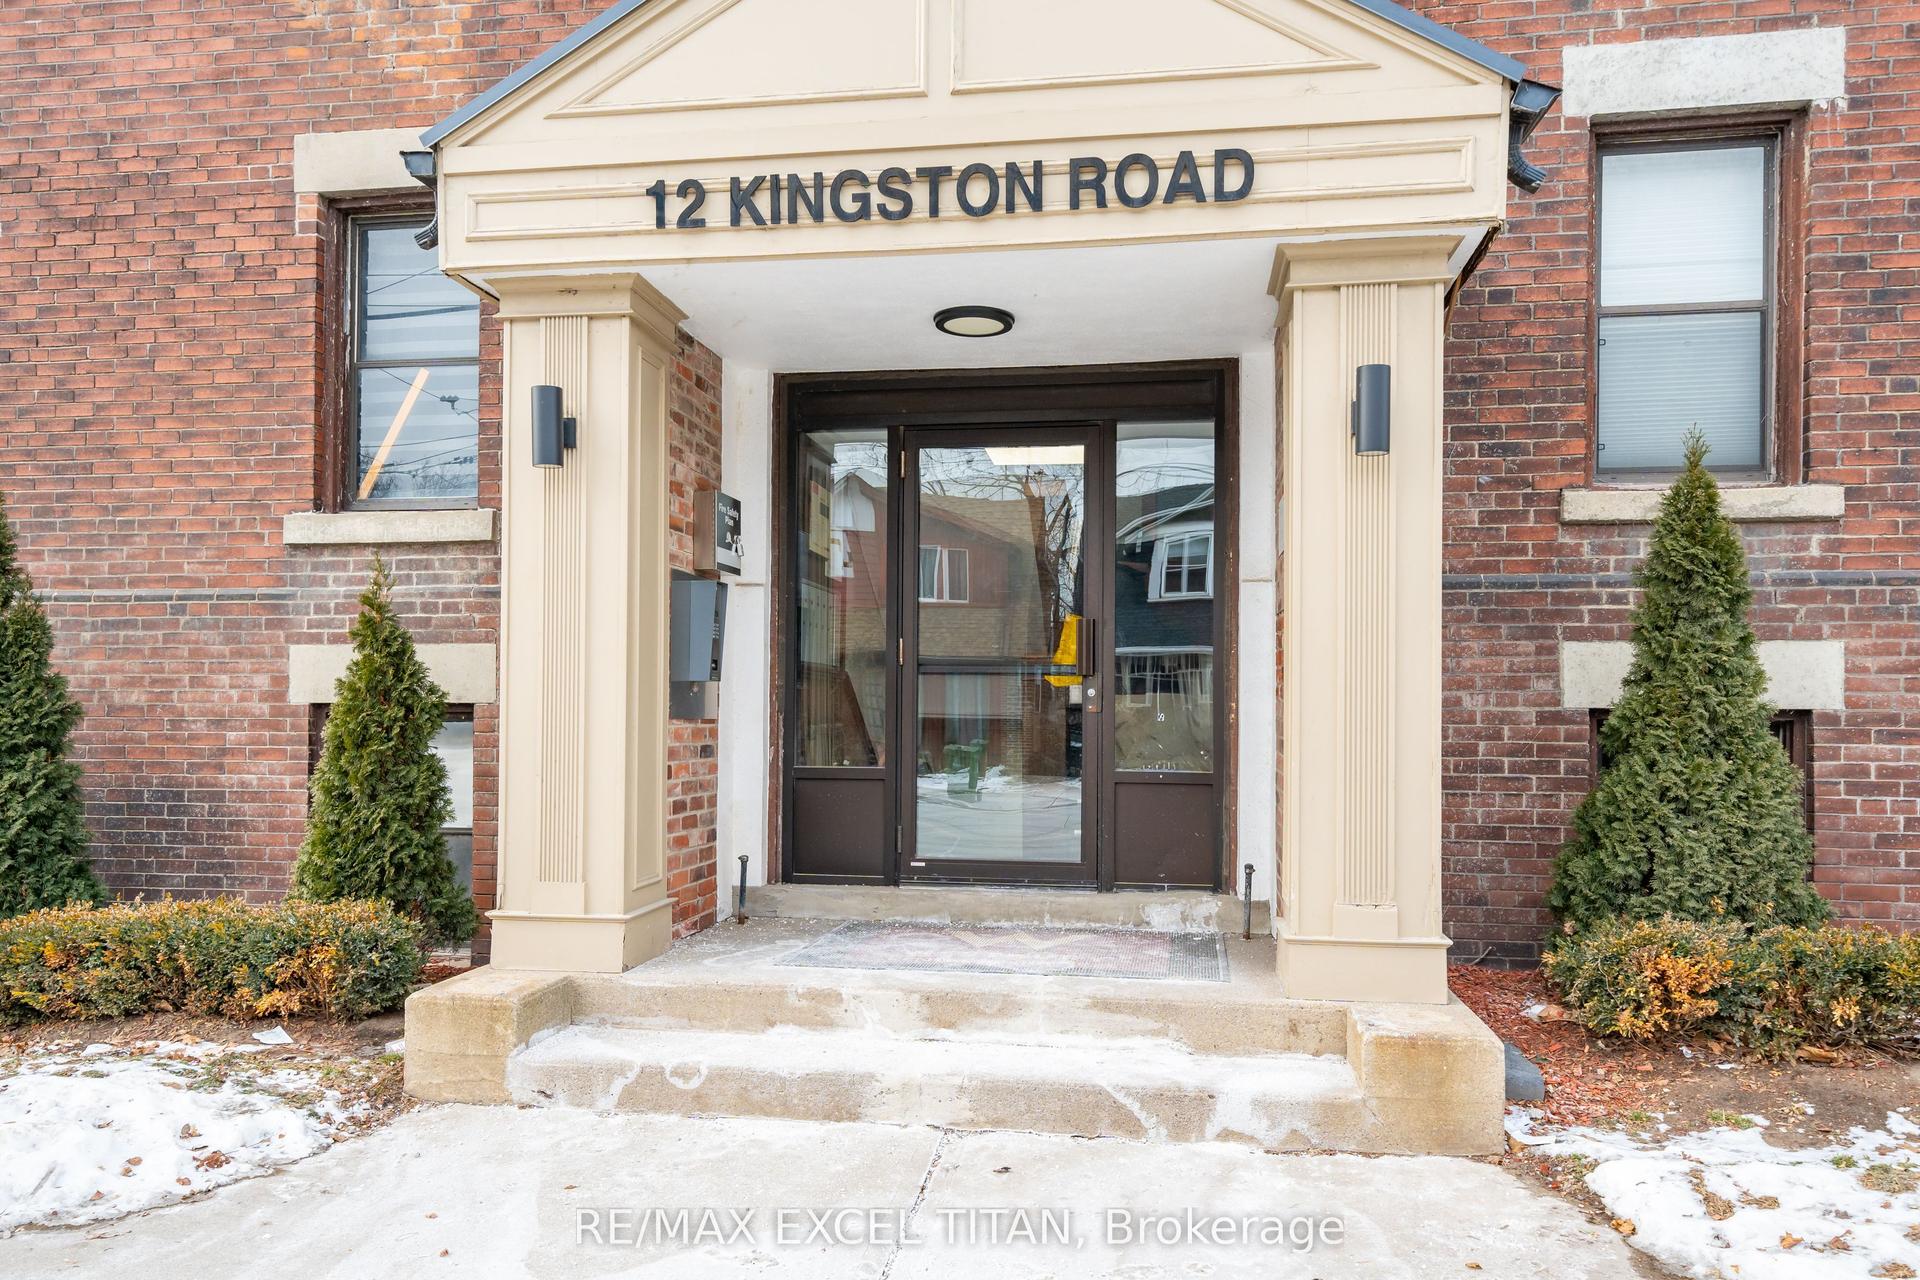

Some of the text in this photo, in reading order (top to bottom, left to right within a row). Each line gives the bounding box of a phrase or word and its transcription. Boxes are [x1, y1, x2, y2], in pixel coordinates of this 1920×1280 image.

[646, 148, 1255, 229] 12 KINGSTON ROAD
[718, 503, 739, 520] Fire Safety
[725, 515, 734, 527] Plan
